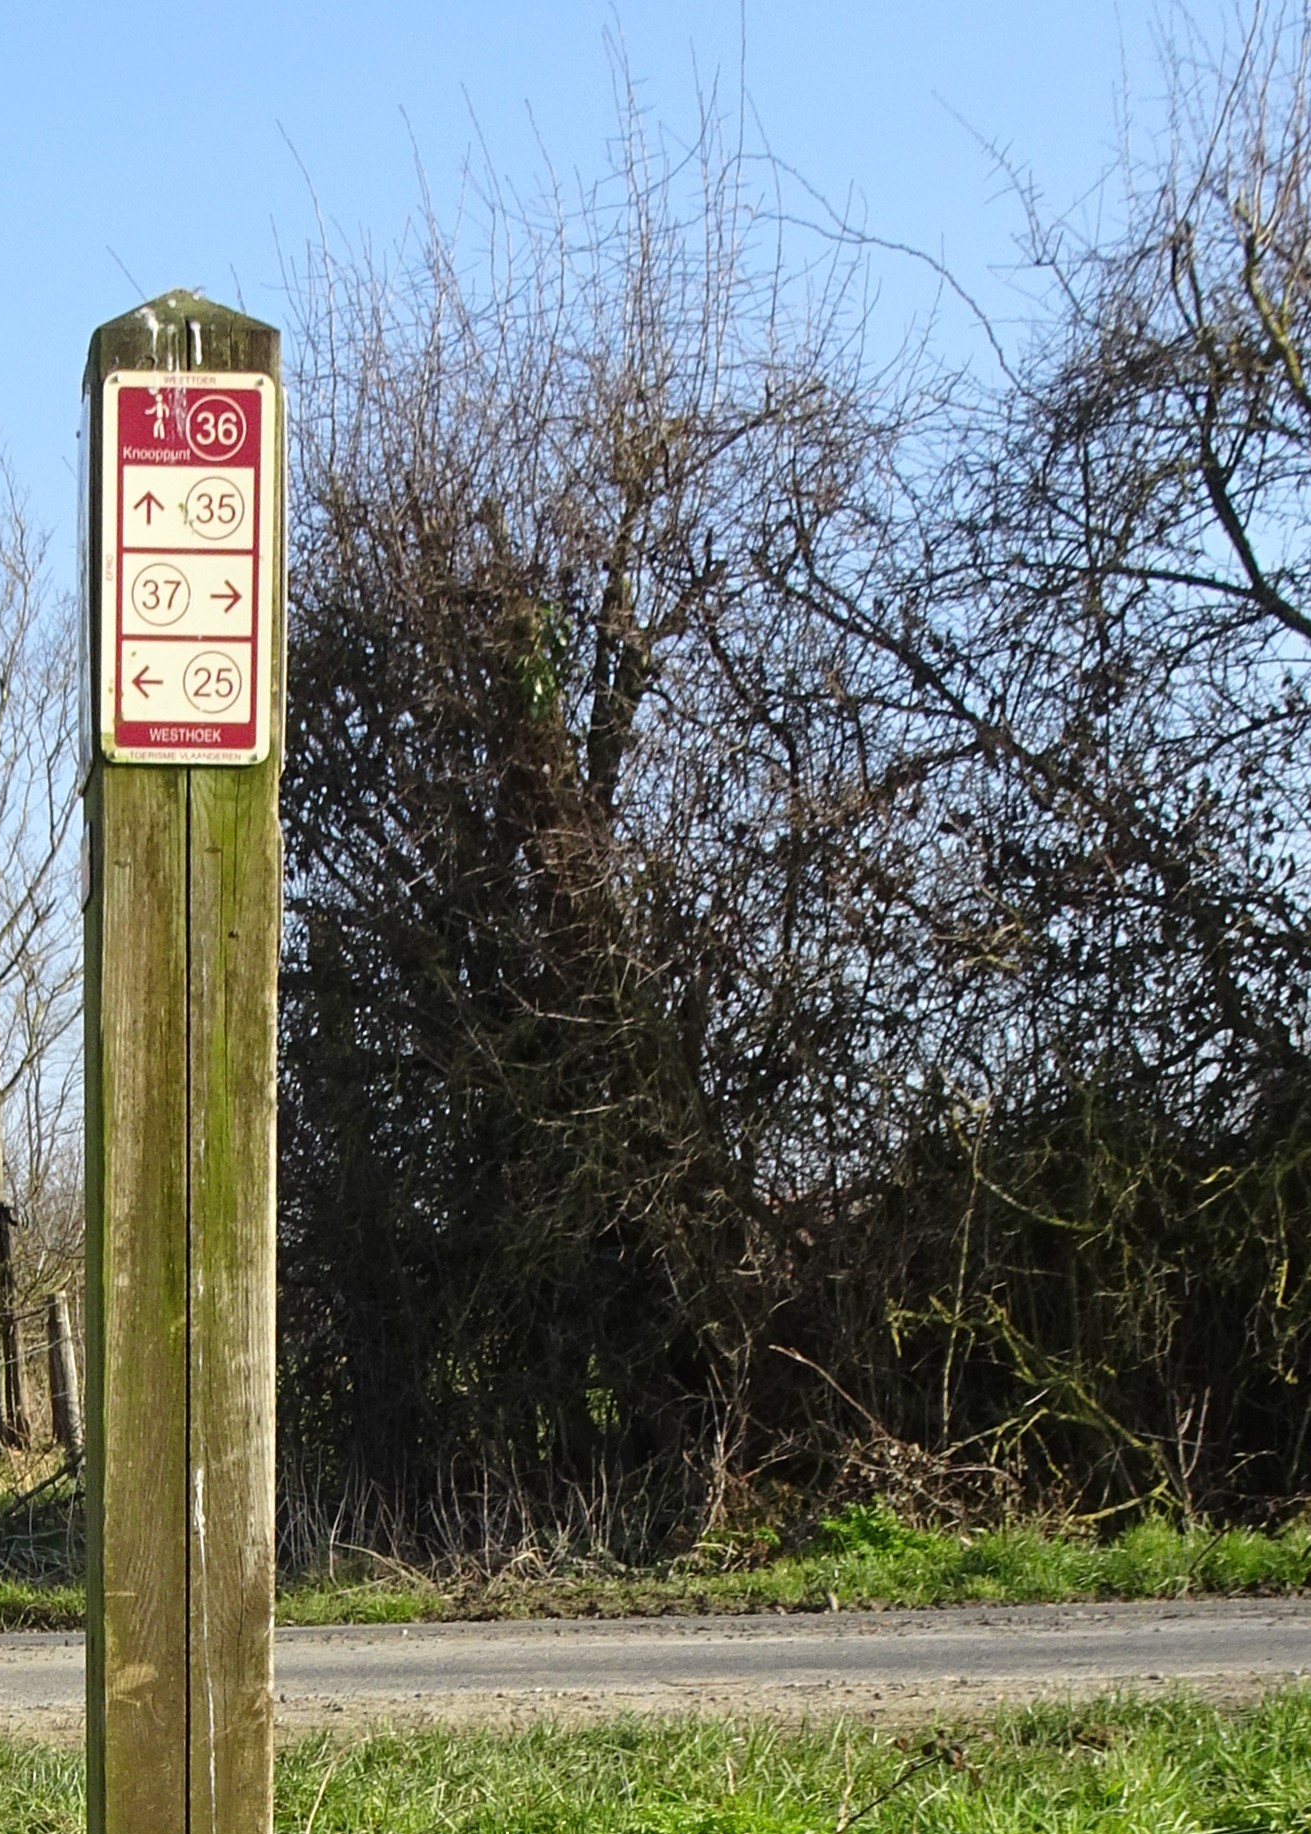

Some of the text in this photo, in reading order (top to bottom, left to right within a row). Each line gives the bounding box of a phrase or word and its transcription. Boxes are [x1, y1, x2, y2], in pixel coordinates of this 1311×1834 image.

[196, 411, 238, 445] 36
[123, 446, 190, 462] Knooppunt
[196, 494, 236, 524] 35
[142, 580, 182, 610] 37
[193, 668, 233, 698] 25
[149, 728, 222, 743] WESTHOEK
